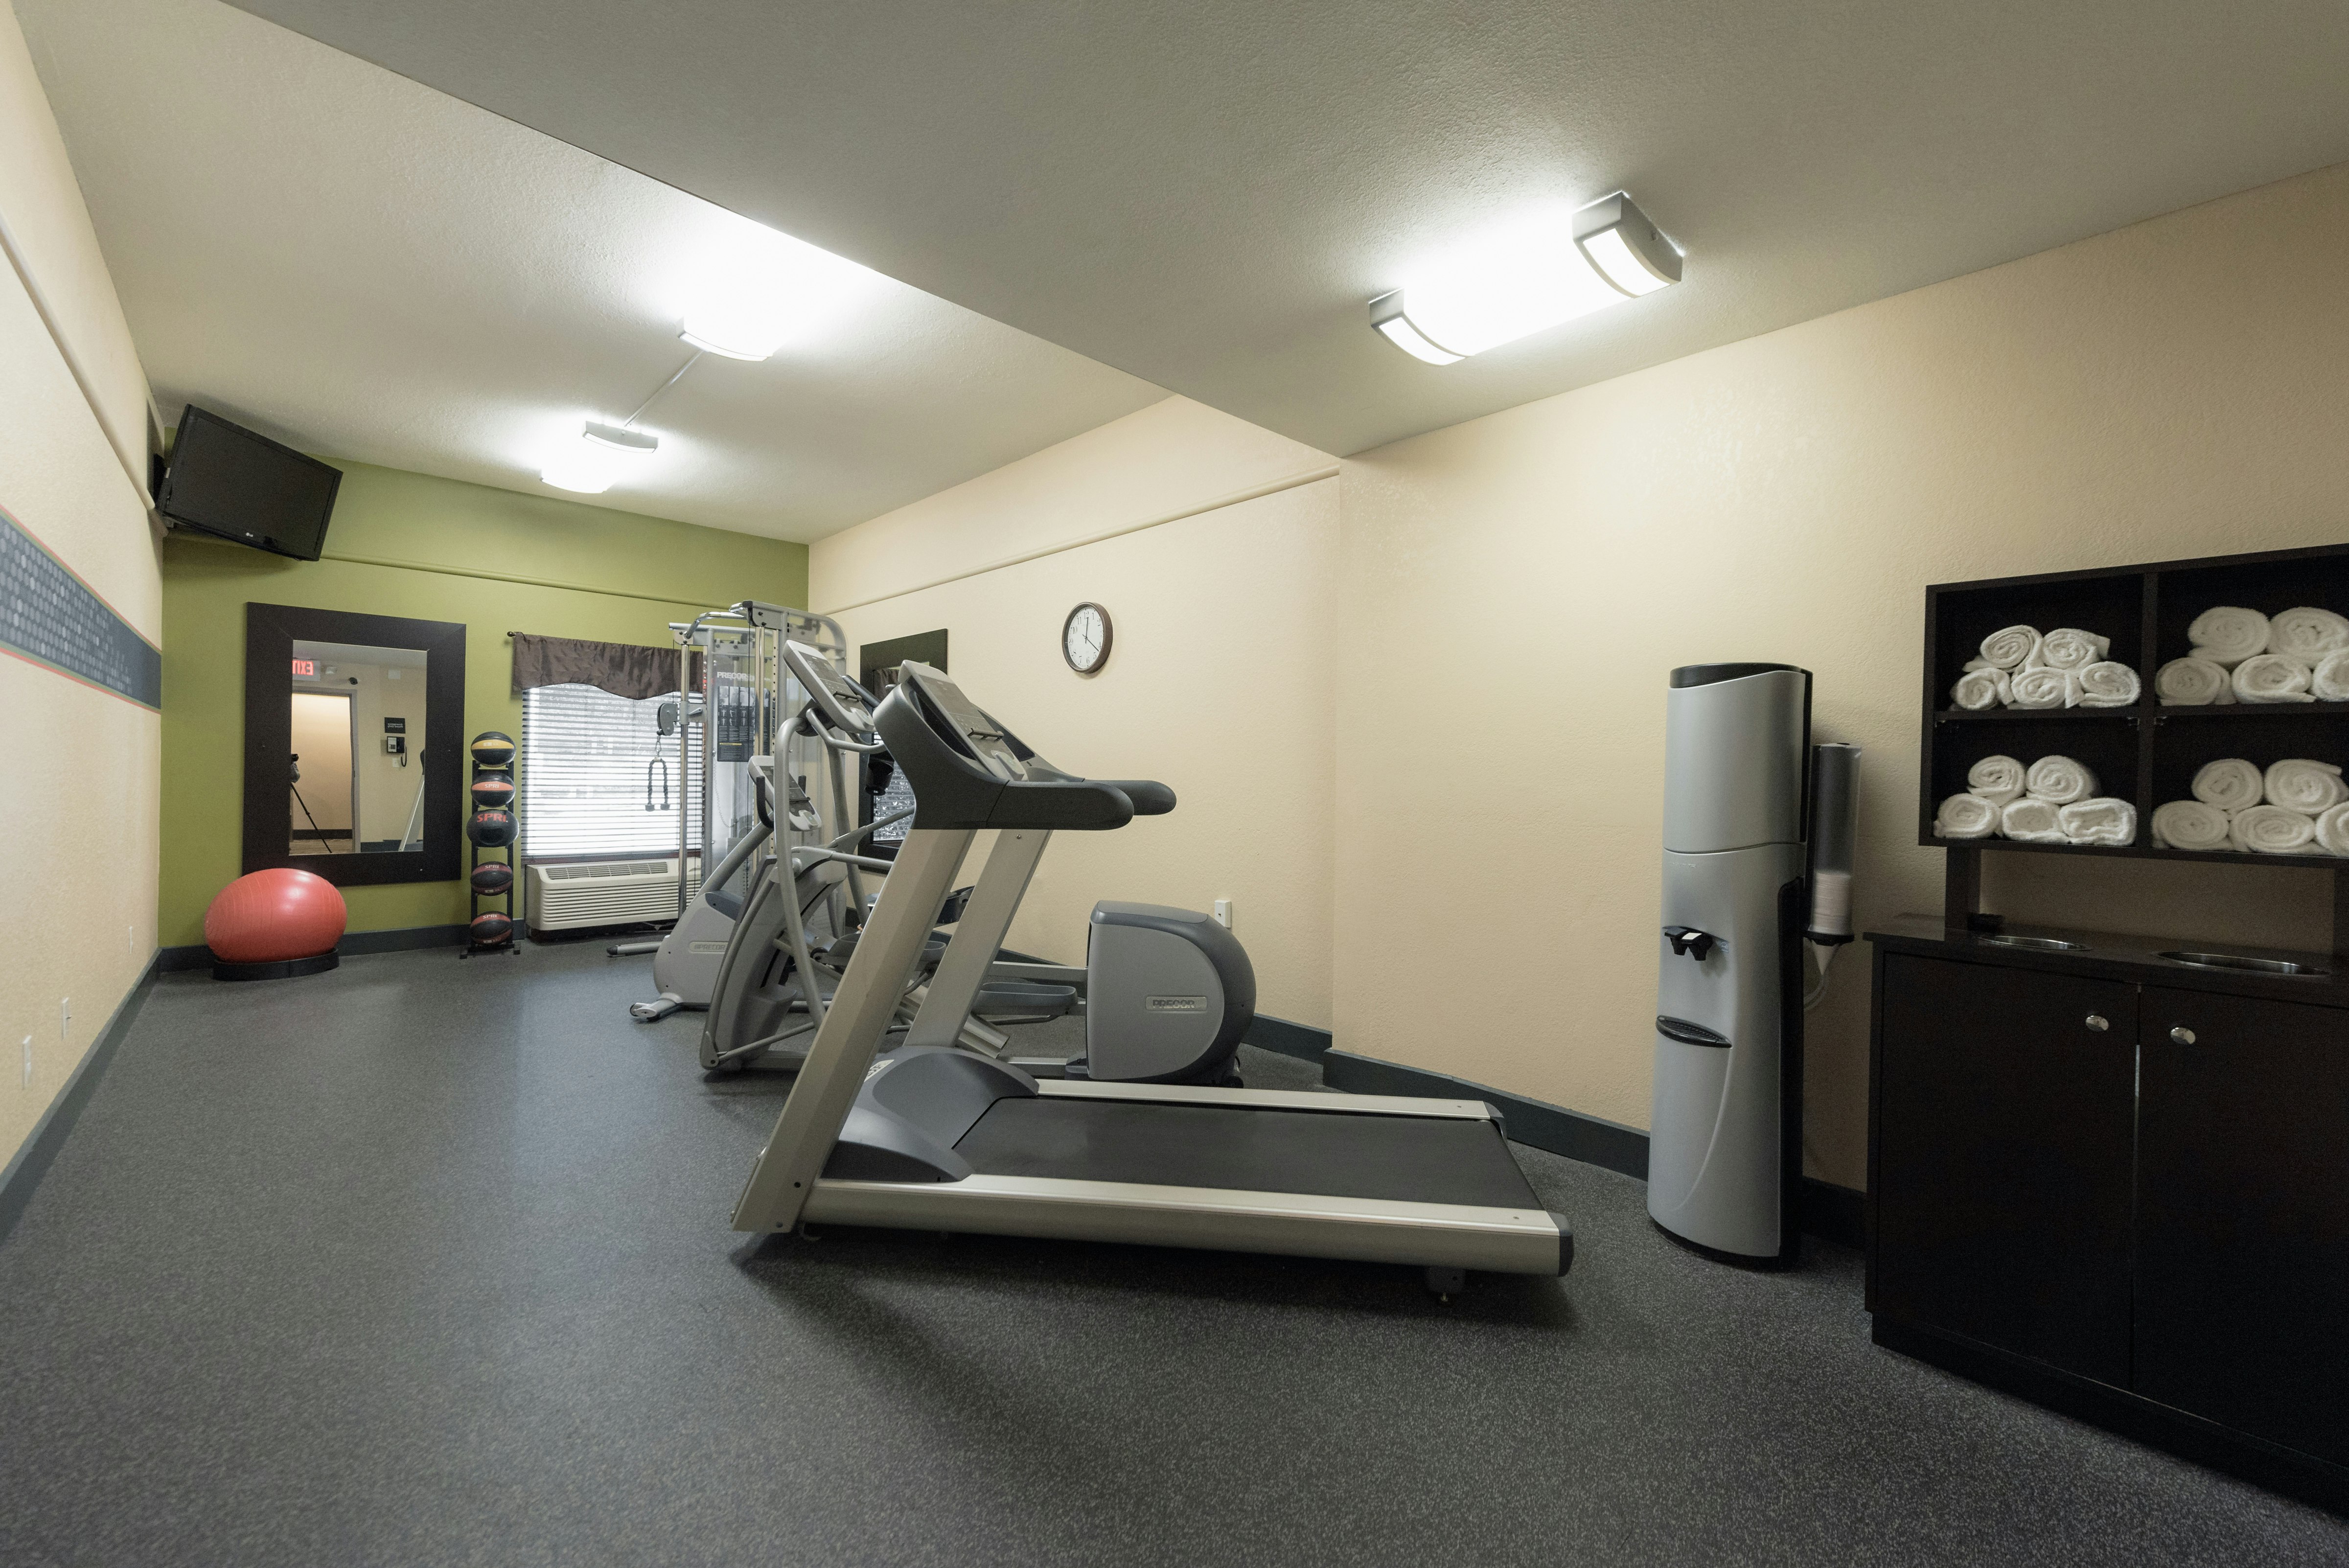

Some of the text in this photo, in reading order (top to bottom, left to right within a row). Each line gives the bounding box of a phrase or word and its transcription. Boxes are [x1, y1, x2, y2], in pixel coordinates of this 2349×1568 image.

[1083, 611, 1089, 620] 12
[1097, 618, 1101, 626] 2
[1079, 655, 1082, 664] 7
[1093, 651, 1097, 660] 5
[1086, 656, 1090, 665] 6
[717, 671, 748, 681] PRECOR
[477, 813, 507, 823] SPRI
[1152, 999, 1195, 1009] PRECOR
